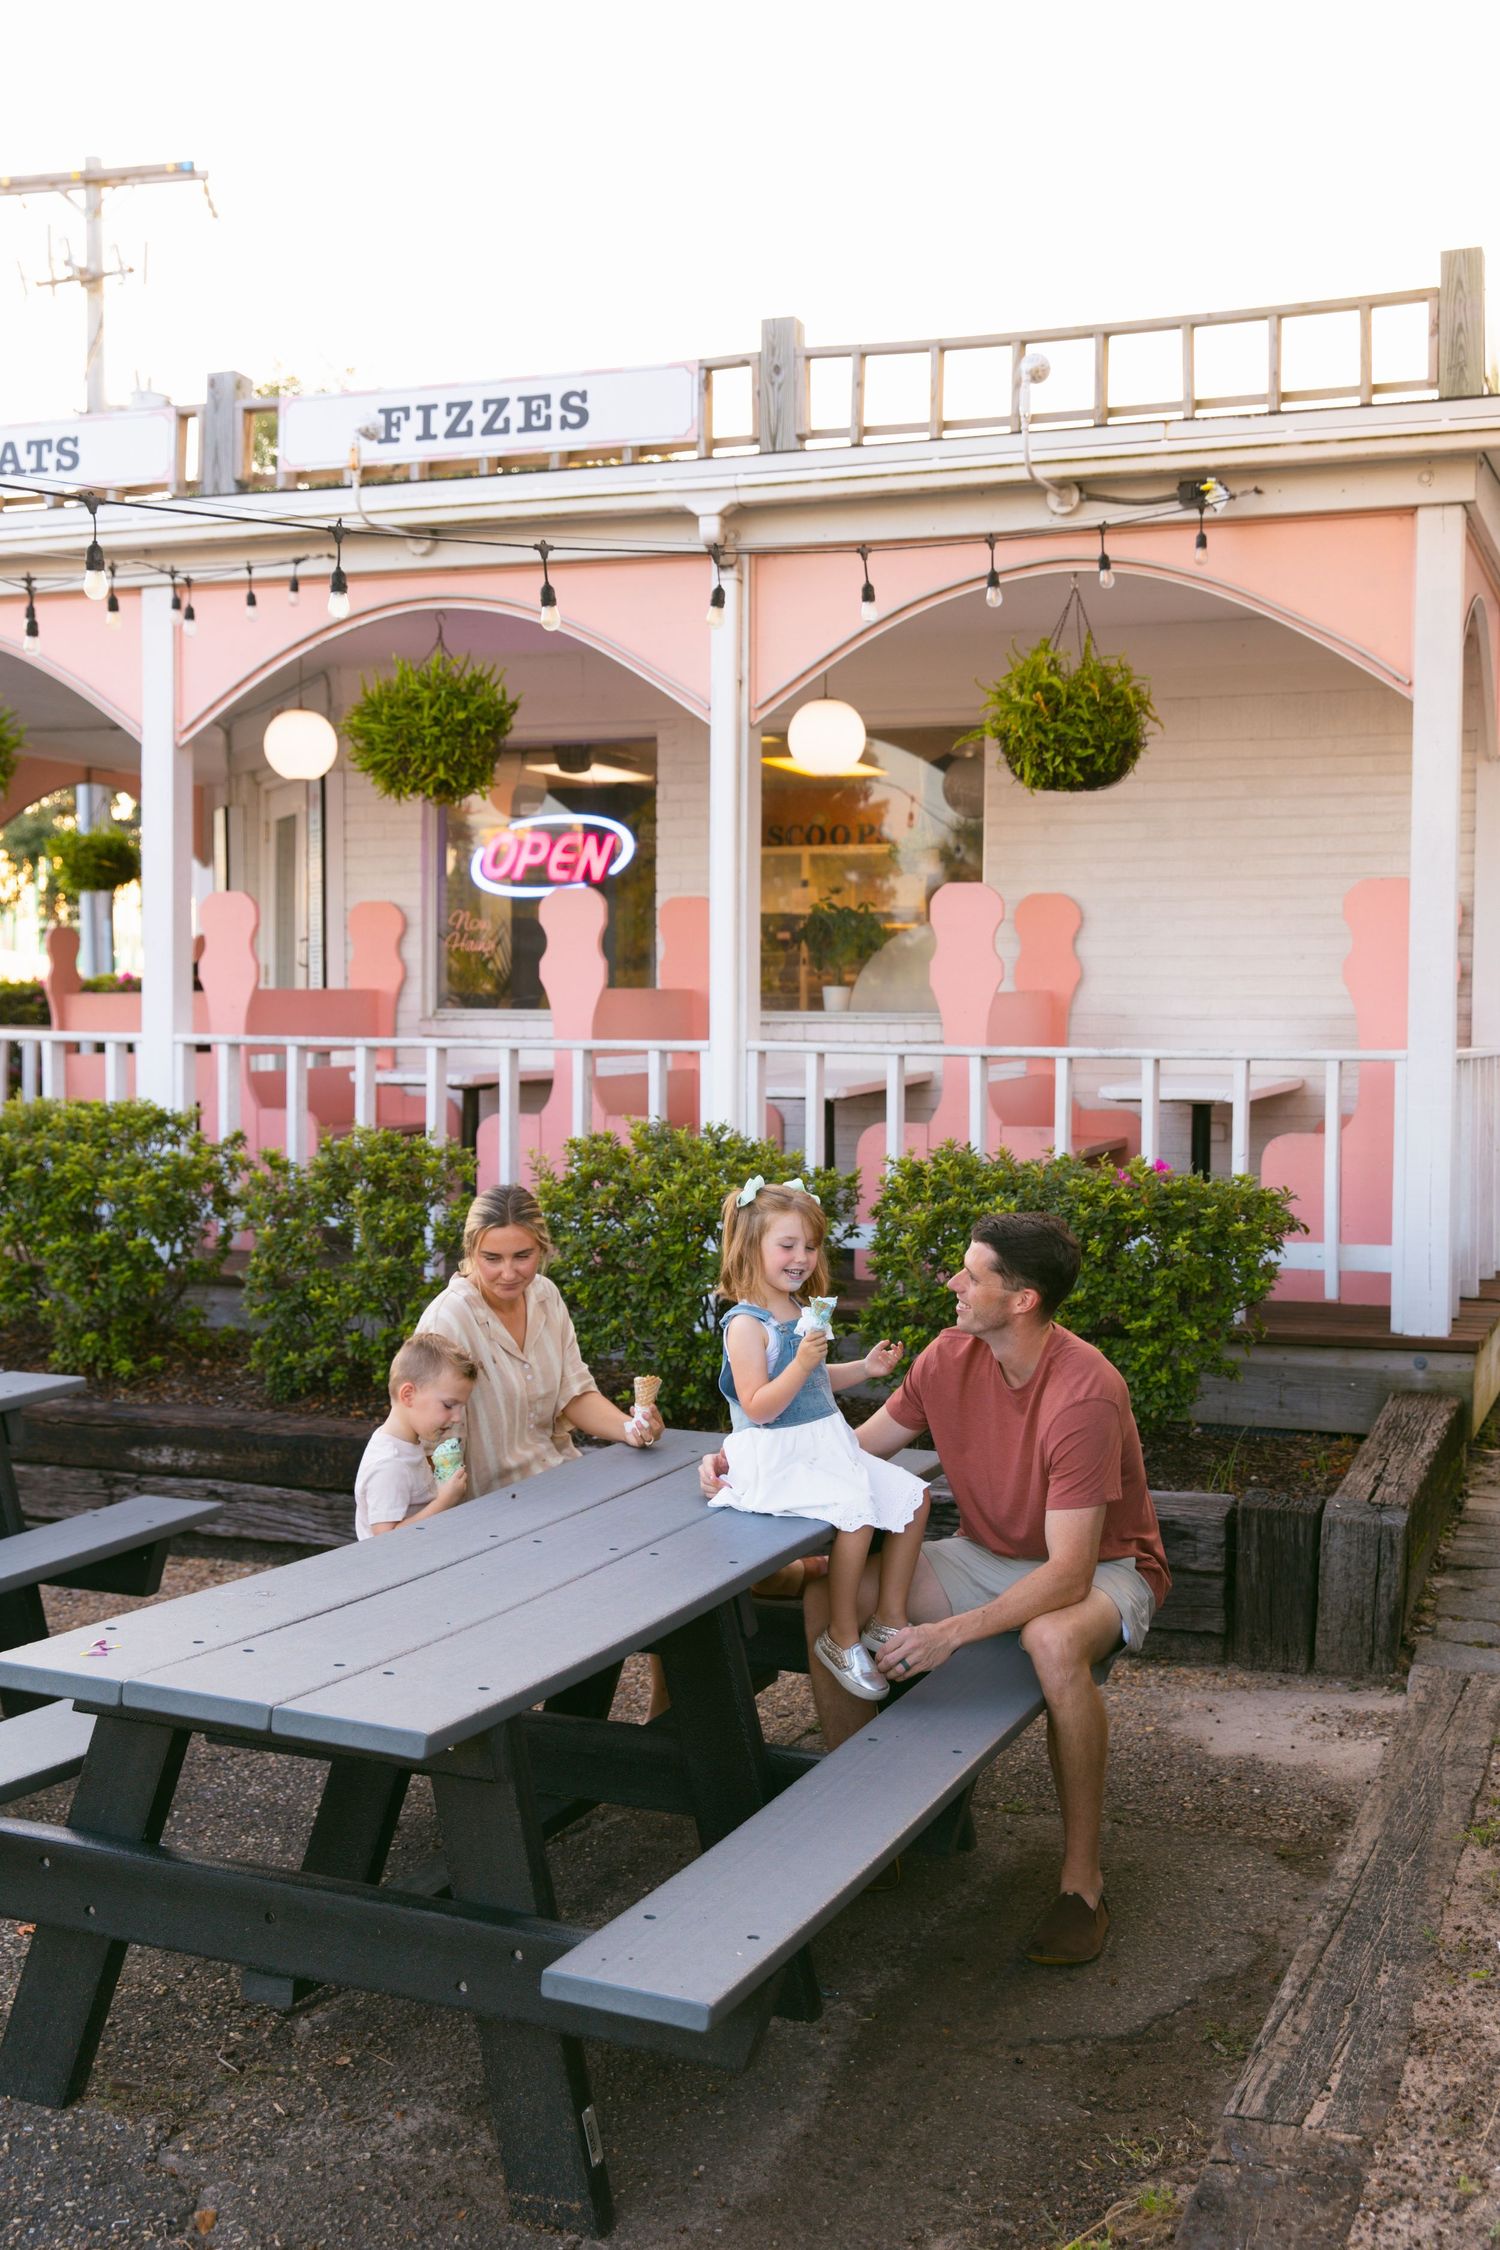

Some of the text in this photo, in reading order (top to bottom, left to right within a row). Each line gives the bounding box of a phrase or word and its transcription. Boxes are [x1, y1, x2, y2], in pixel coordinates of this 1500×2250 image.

[377, 389, 590, 444] FIZZES
[0, 436, 80, 475] ATS
[482, 831, 617, 884] OPEN
